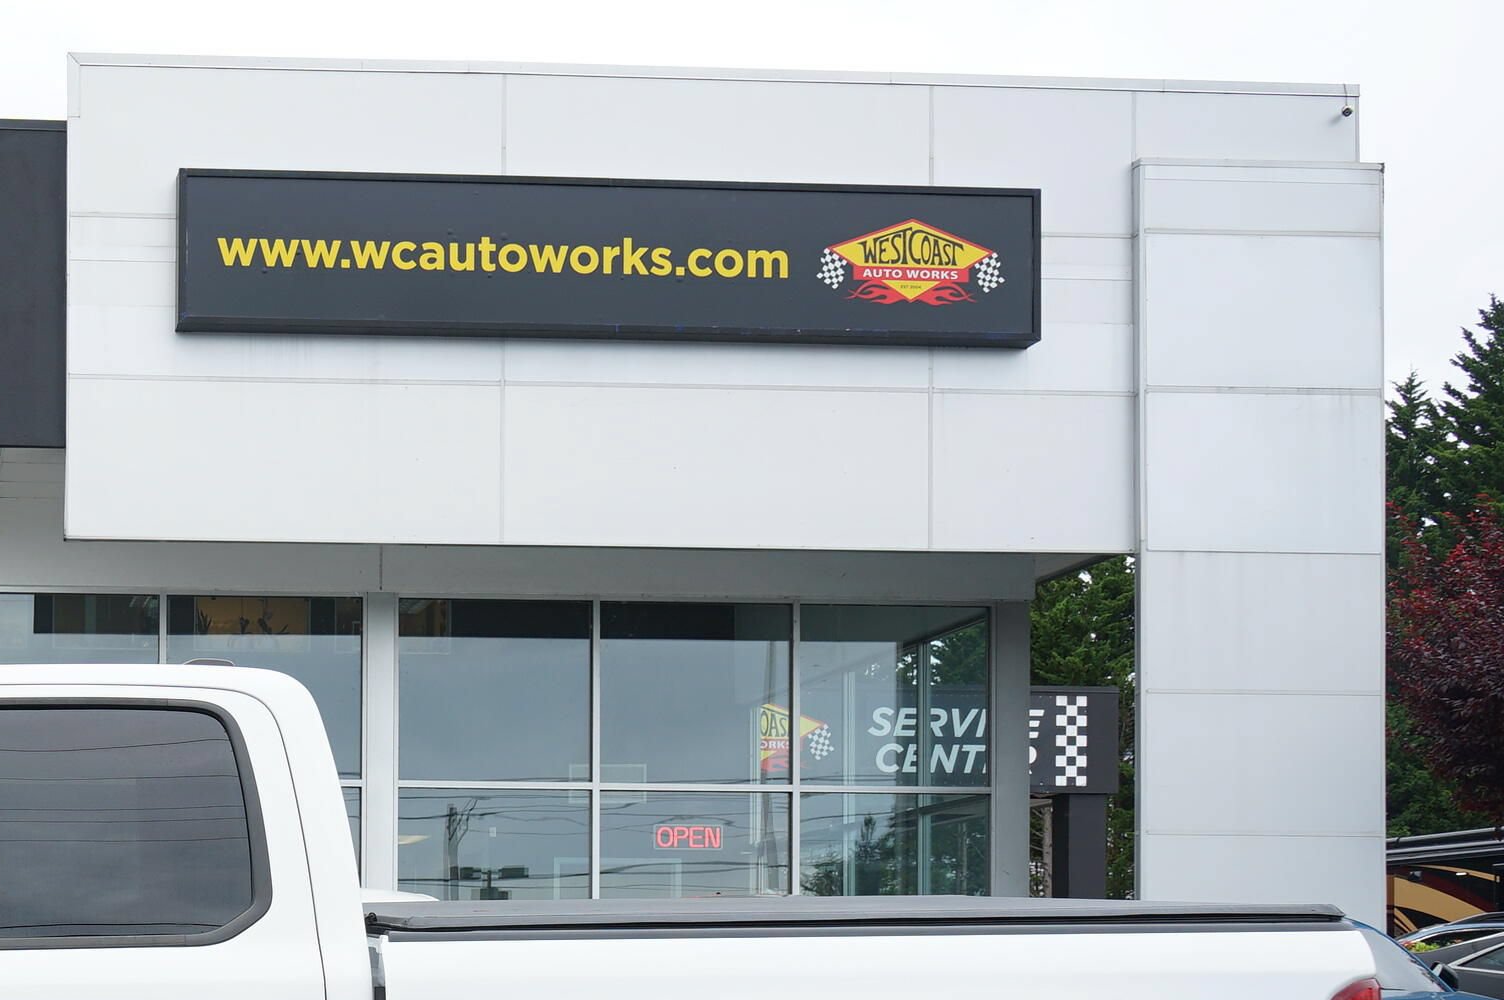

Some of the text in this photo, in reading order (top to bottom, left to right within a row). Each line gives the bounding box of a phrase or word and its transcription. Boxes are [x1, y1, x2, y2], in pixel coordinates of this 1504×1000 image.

[217, 236, 789, 279] www.wcautoworks.com
[862, 268, 959, 280] AUTO WORKS
[867, 707, 1045, 738] SERVIE
[656, 826, 721, 848] OPEN
